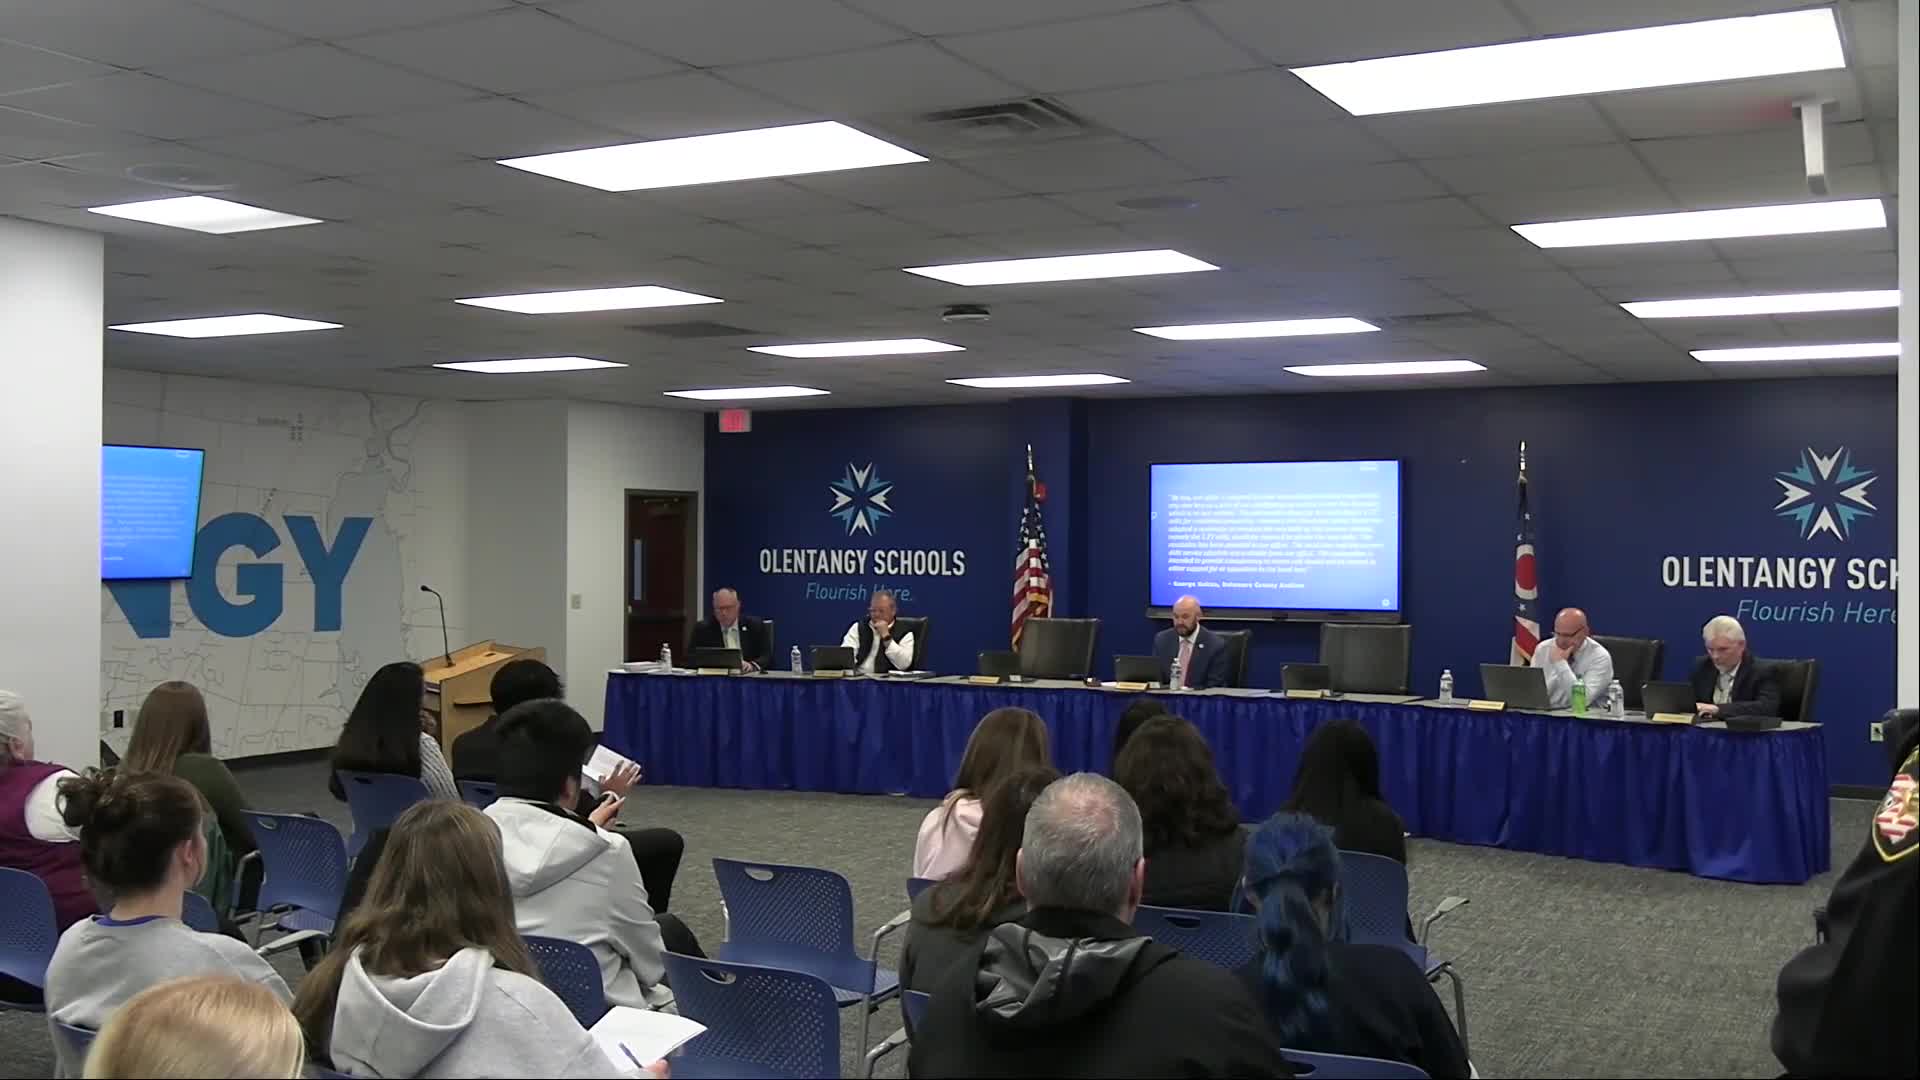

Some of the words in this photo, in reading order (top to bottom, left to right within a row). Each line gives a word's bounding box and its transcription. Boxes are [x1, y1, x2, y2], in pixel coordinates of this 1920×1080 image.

[759, 549, 868, 575] OLENTANGY
[873, 550, 966, 577] SCHOOLS
[1662, 556, 1836, 589] OLENTANGY
[806, 581, 868, 601] Flourish
[1736, 600, 1834, 623] Flourish
